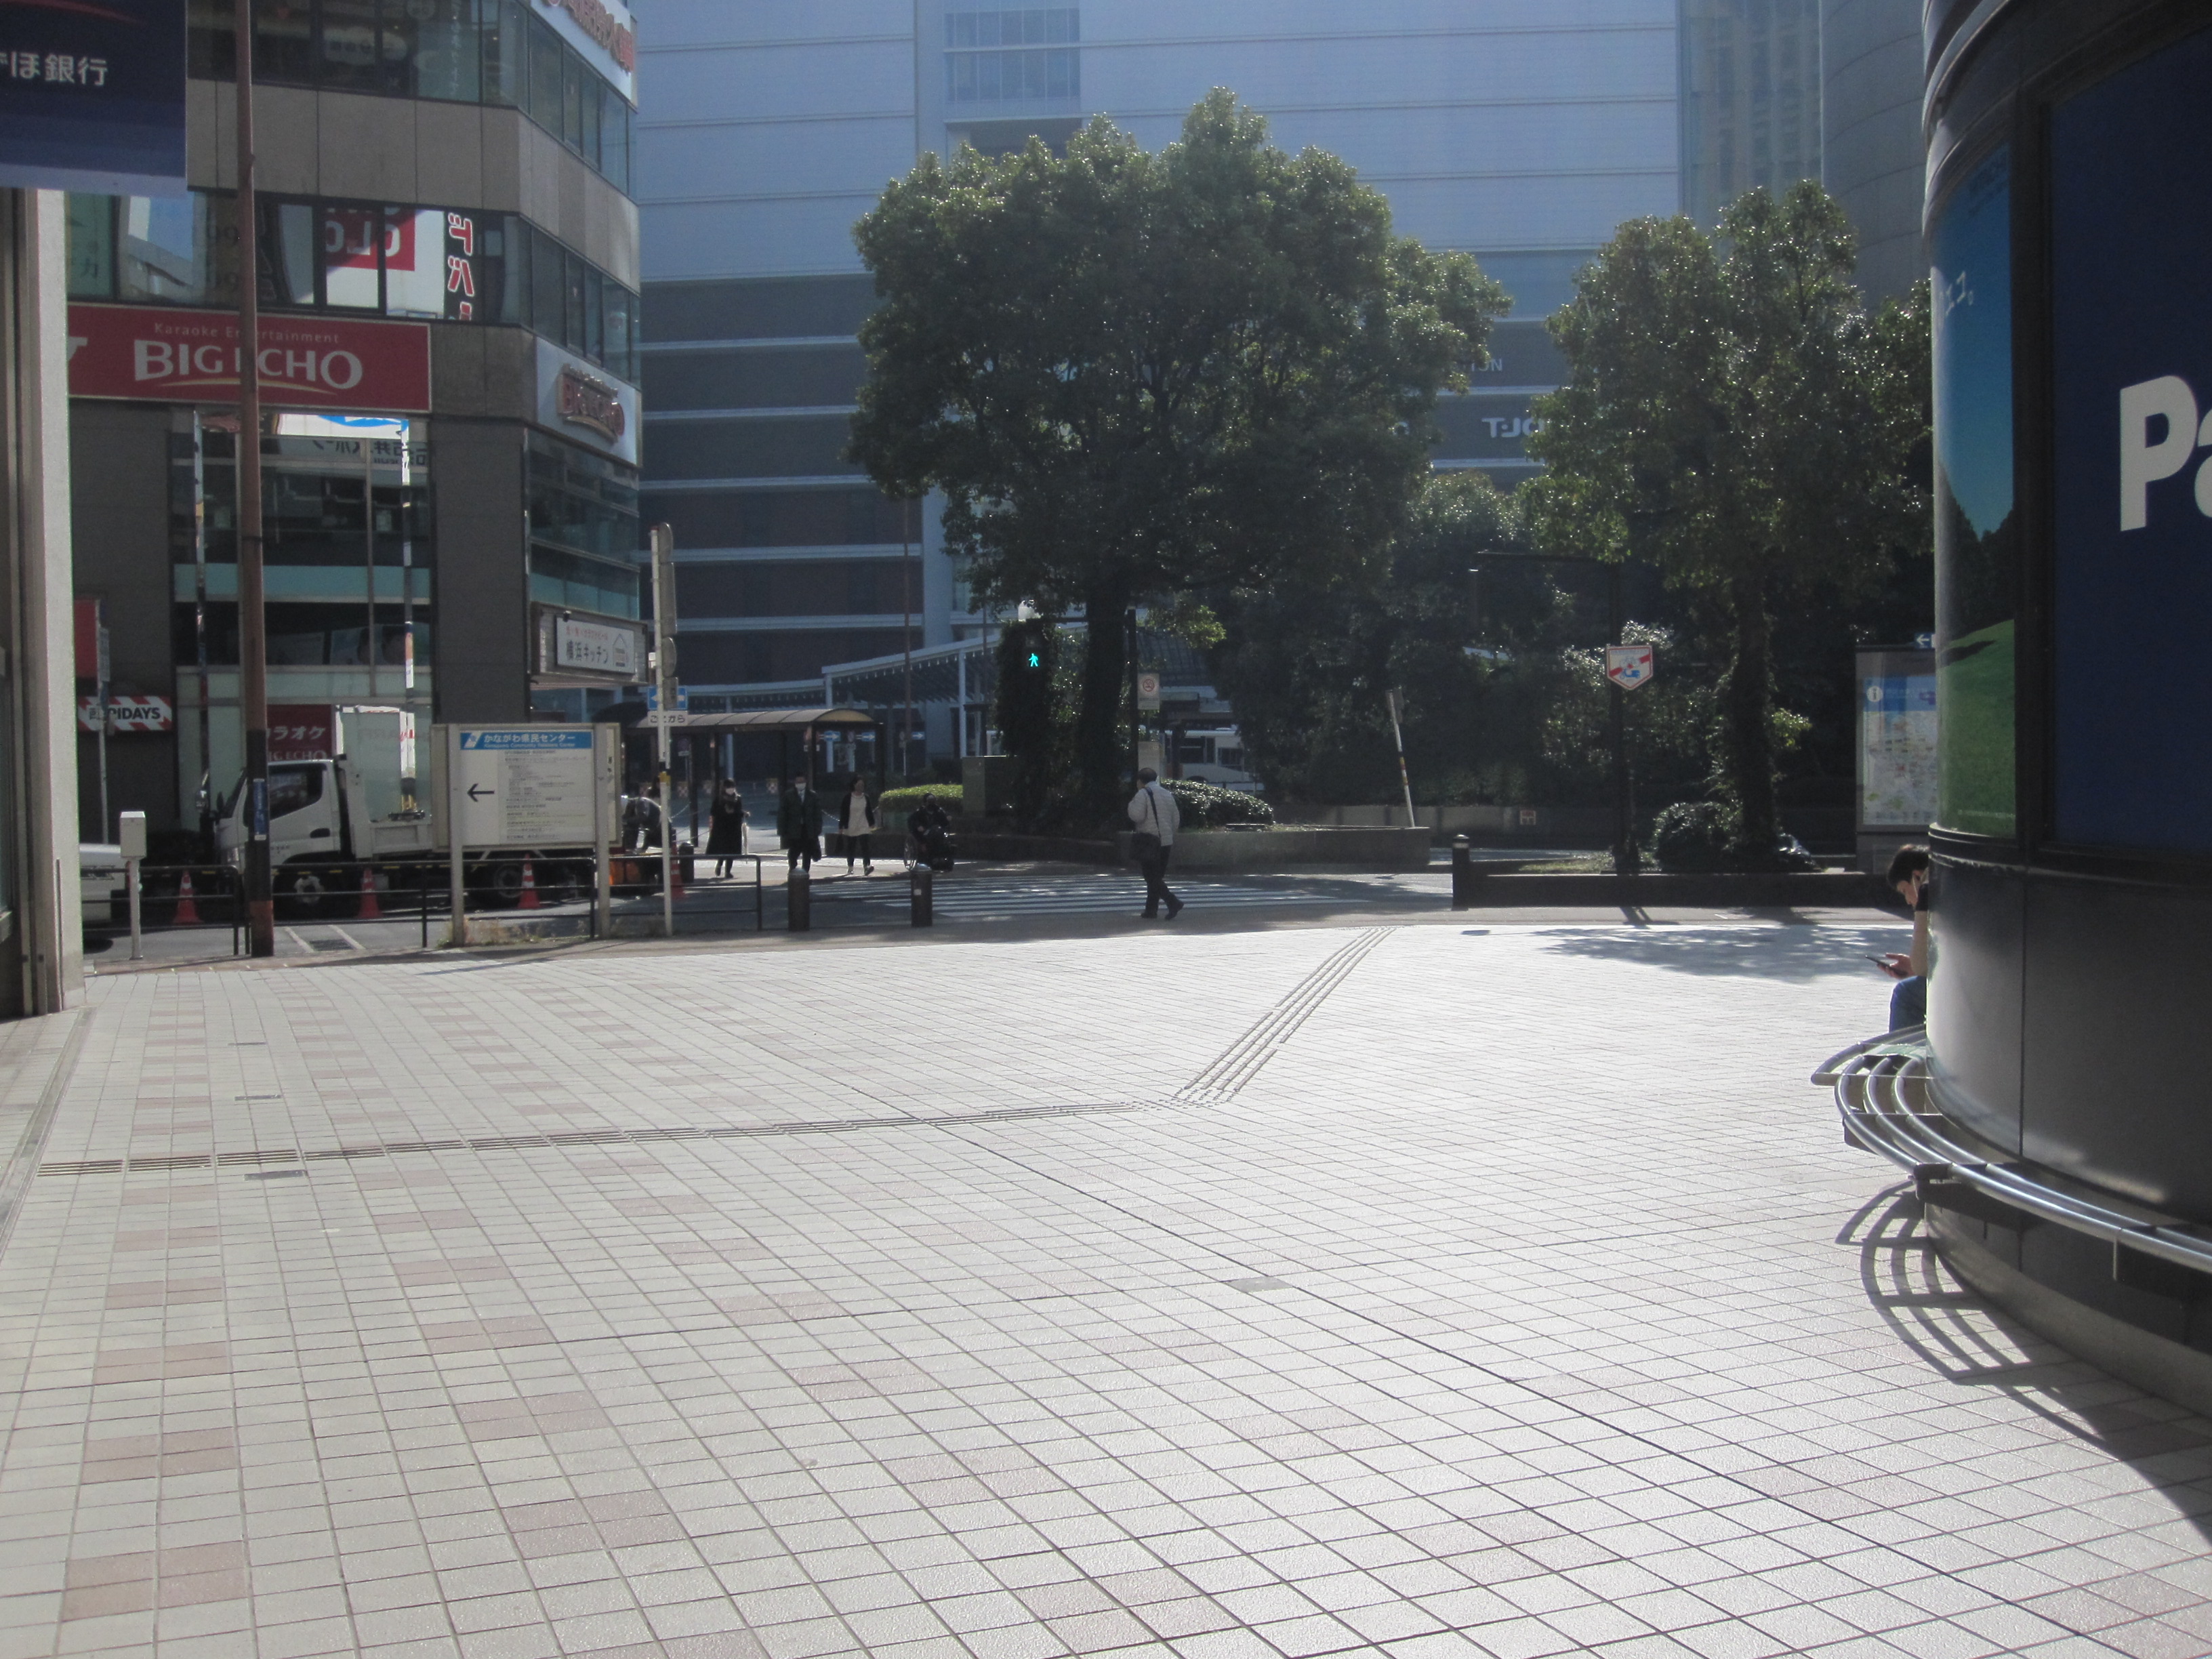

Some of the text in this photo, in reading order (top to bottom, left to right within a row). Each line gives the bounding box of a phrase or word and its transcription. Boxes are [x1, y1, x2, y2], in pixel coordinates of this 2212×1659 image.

[0, 52, 108, 86] ほ銀行
[155, 322, 218, 337] Karaoke
[135, 339, 224, 382] BIG
[234, 346, 363, 390] CHO
[484, 734, 575, 743] かながわ県民センター
